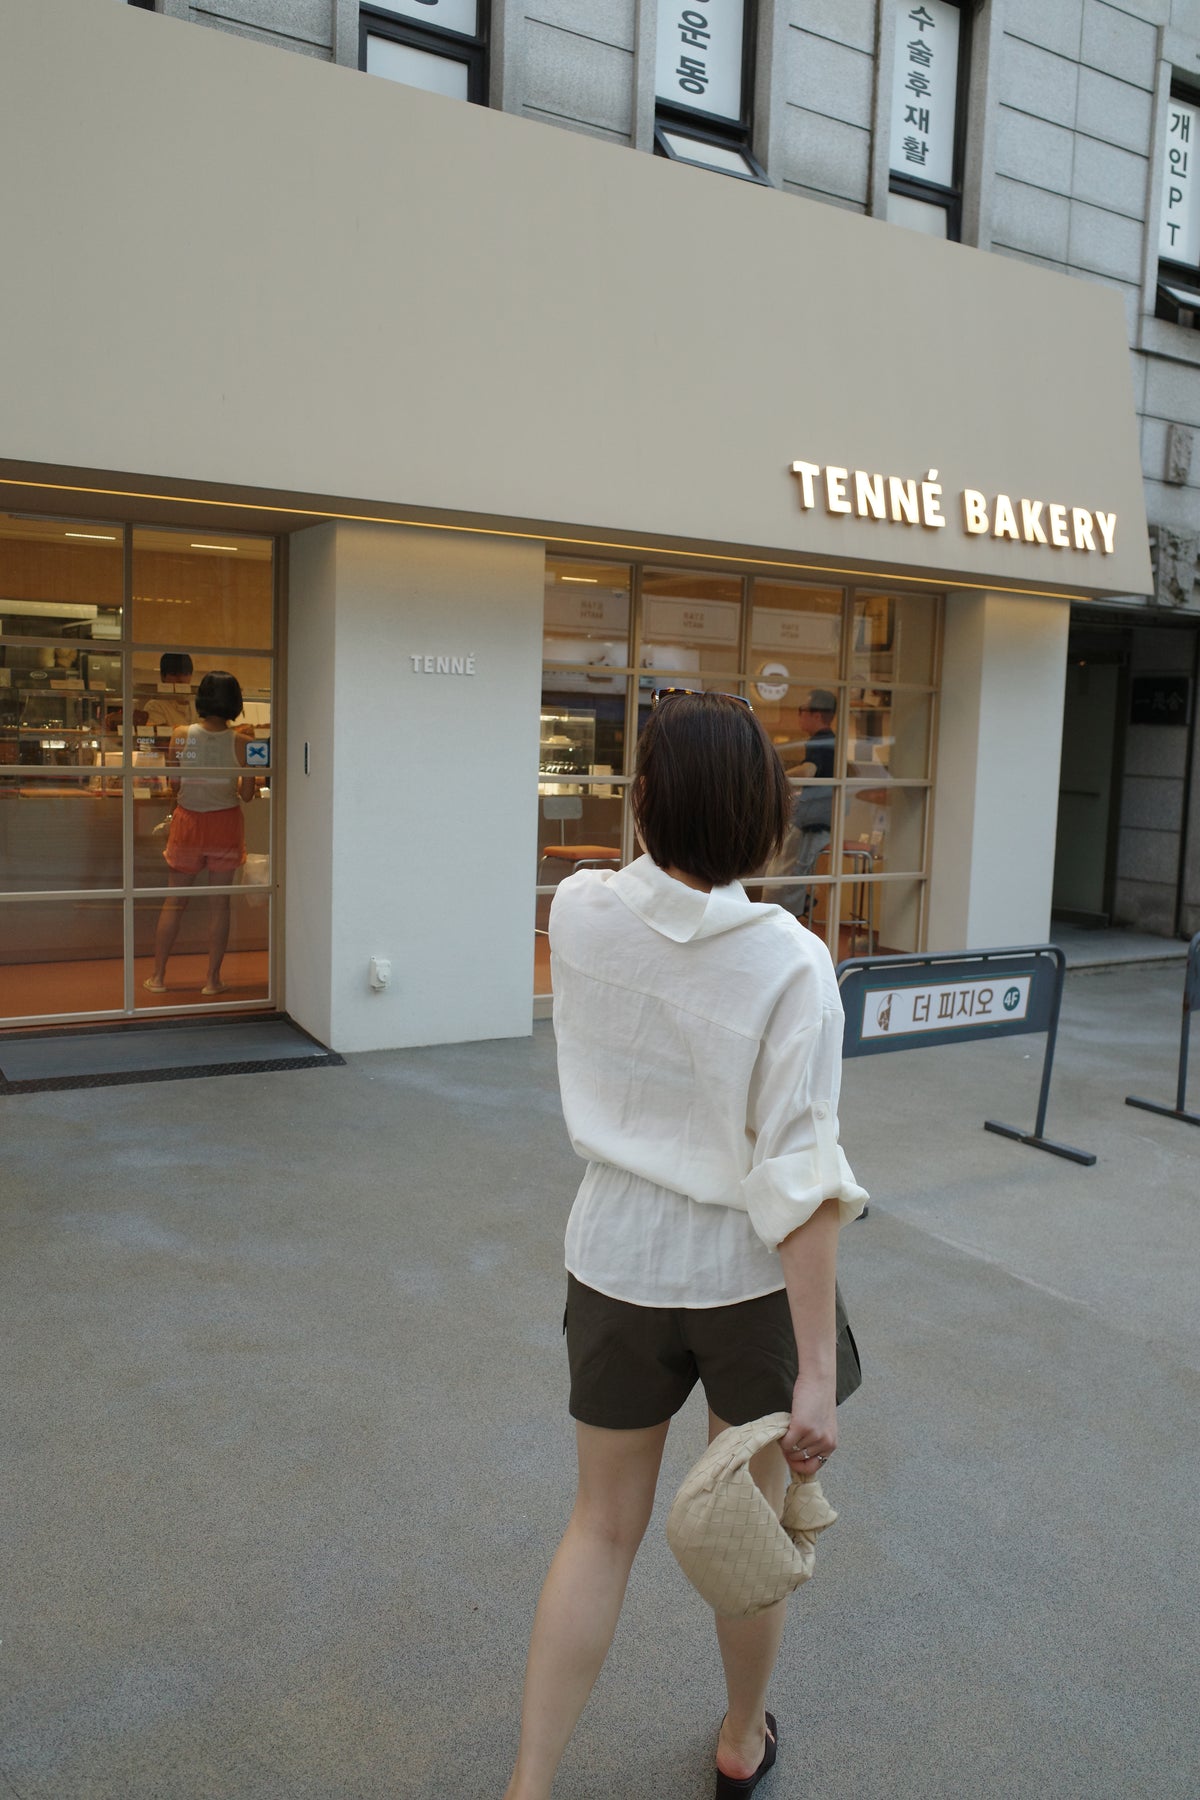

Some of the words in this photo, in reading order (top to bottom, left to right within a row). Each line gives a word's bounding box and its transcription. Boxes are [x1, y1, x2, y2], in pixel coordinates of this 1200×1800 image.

[676, 0, 711, 95] 운동
[792, 460, 946, 528] TENNÉ
[962, 488, 1117, 554] BAKERY
[410, 652, 476, 676] TENNÉ
[912, 993, 931, 1022] 더
[937, 988, 994, 1020] 피지오
[1004, 991, 1018, 1007] 4F
